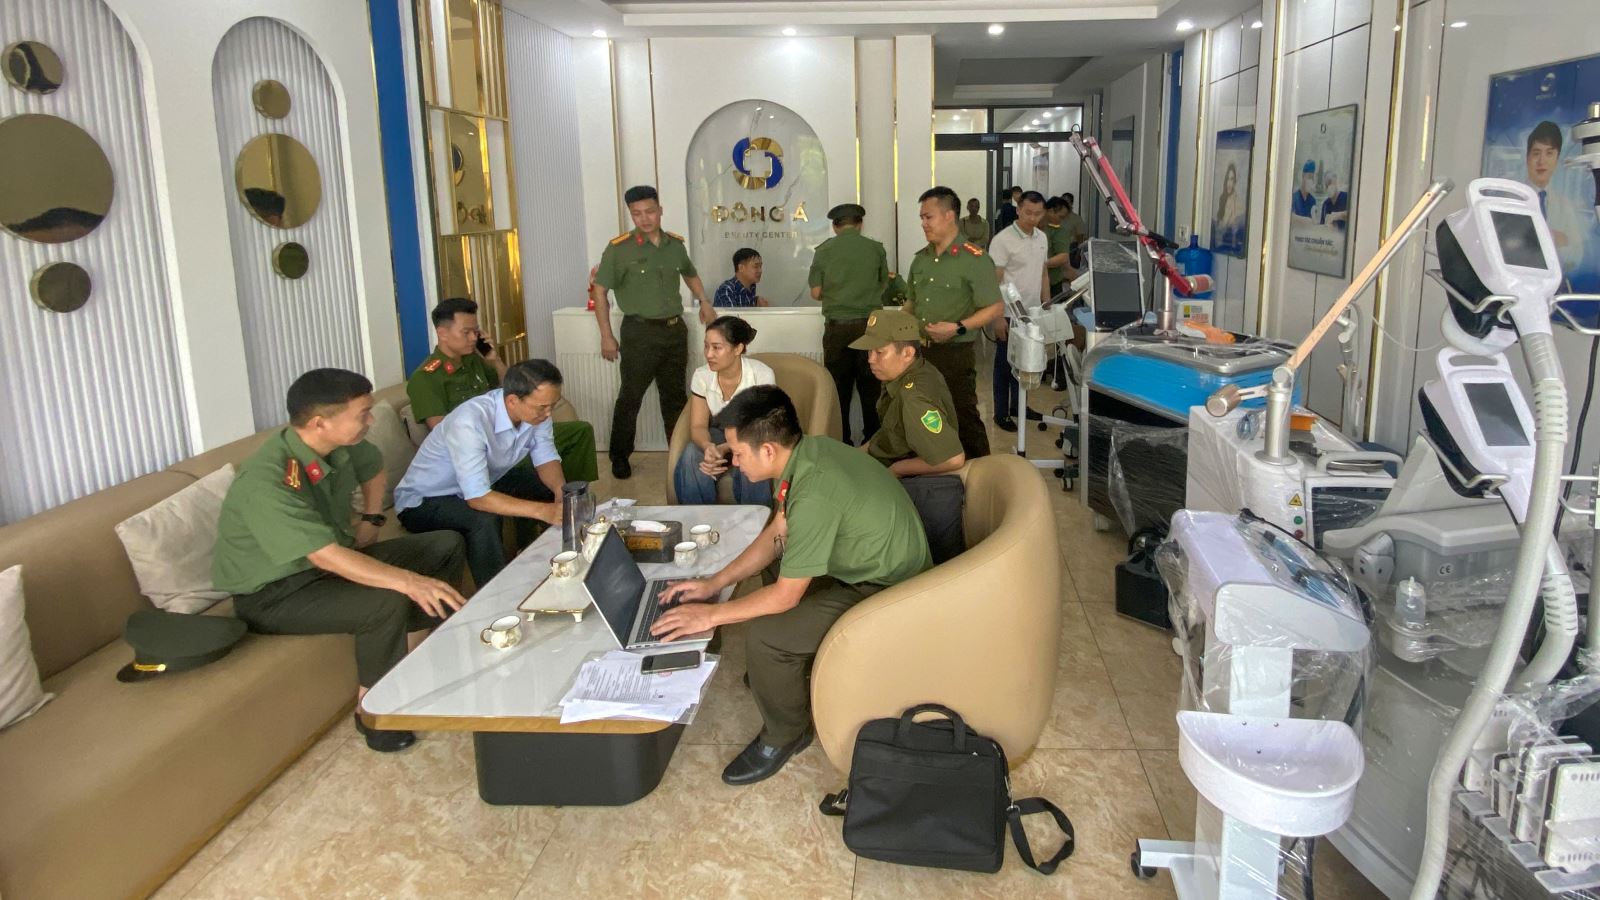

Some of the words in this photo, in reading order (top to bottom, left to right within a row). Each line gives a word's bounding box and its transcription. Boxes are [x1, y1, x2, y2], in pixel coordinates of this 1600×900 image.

[711, 201, 785, 222] ĐÔNG
[793, 201, 808, 222] Á
[762, 231, 798, 239] CENTER
